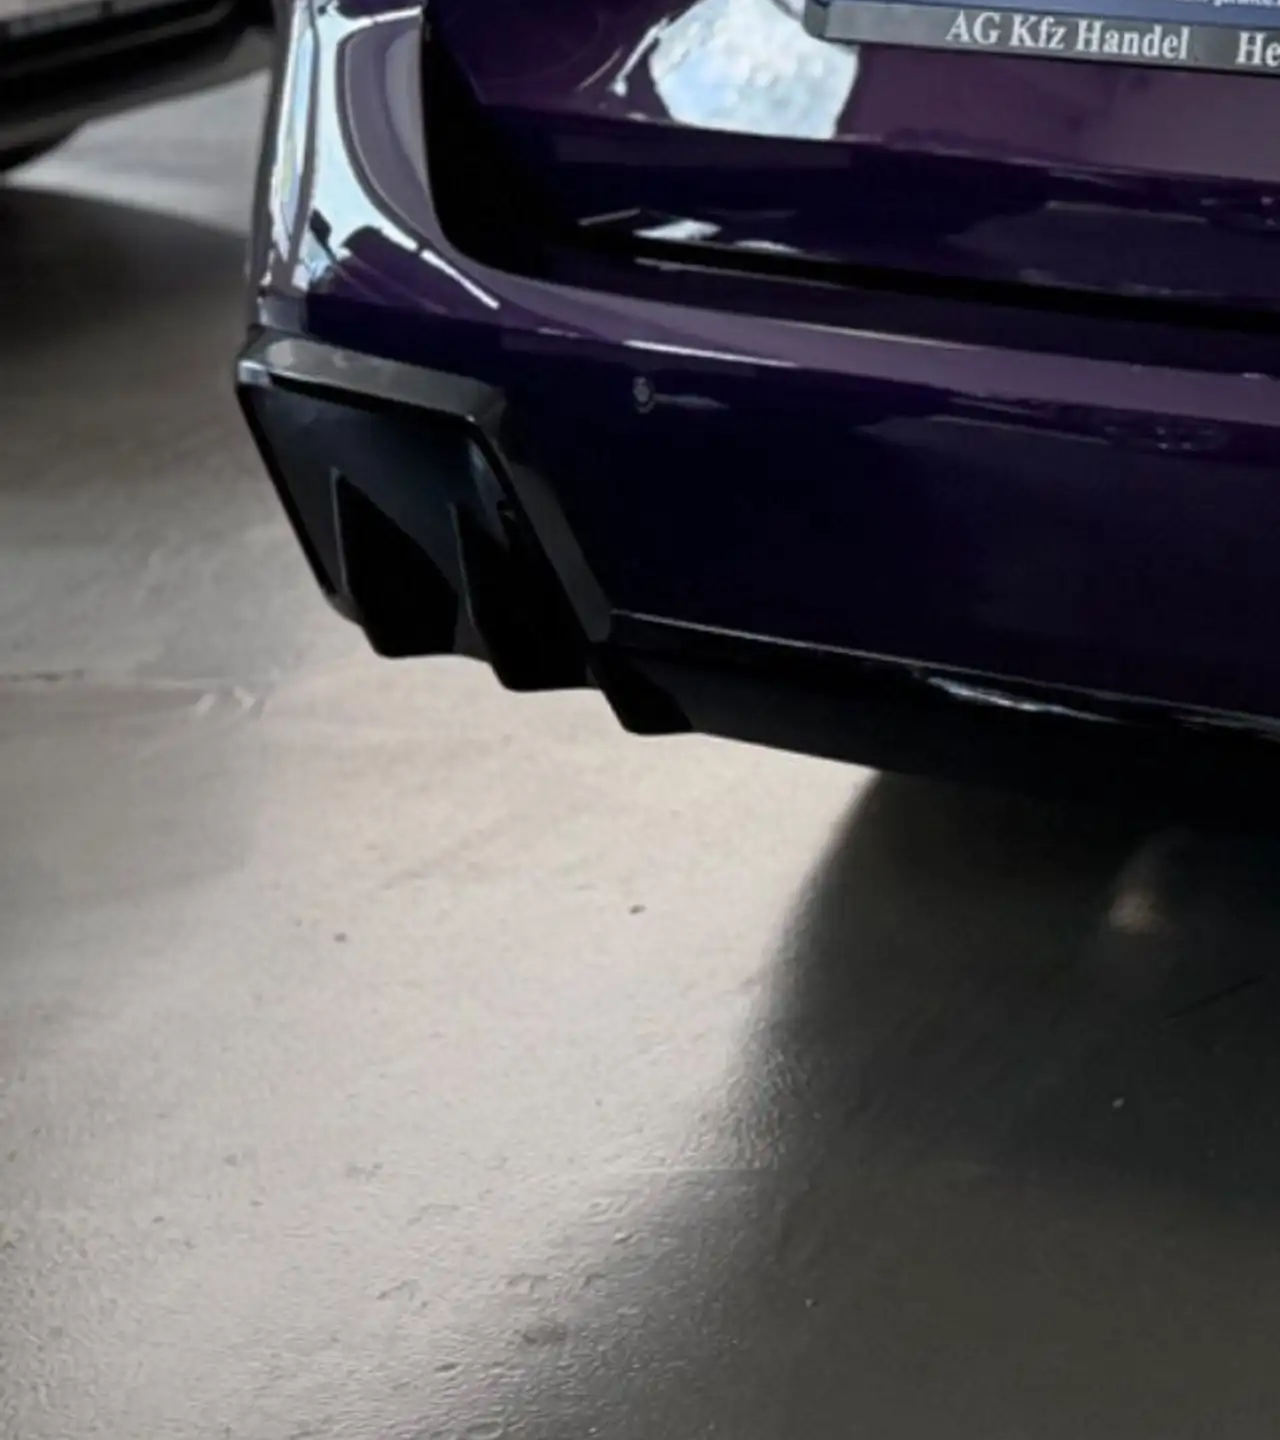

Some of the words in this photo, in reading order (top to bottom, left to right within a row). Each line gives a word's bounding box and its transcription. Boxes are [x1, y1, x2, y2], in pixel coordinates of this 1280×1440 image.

[945, 11, 1001, 46] AG
[1008, 16, 1066, 51] Kfz
[1075, 21, 1190, 60] Handel
